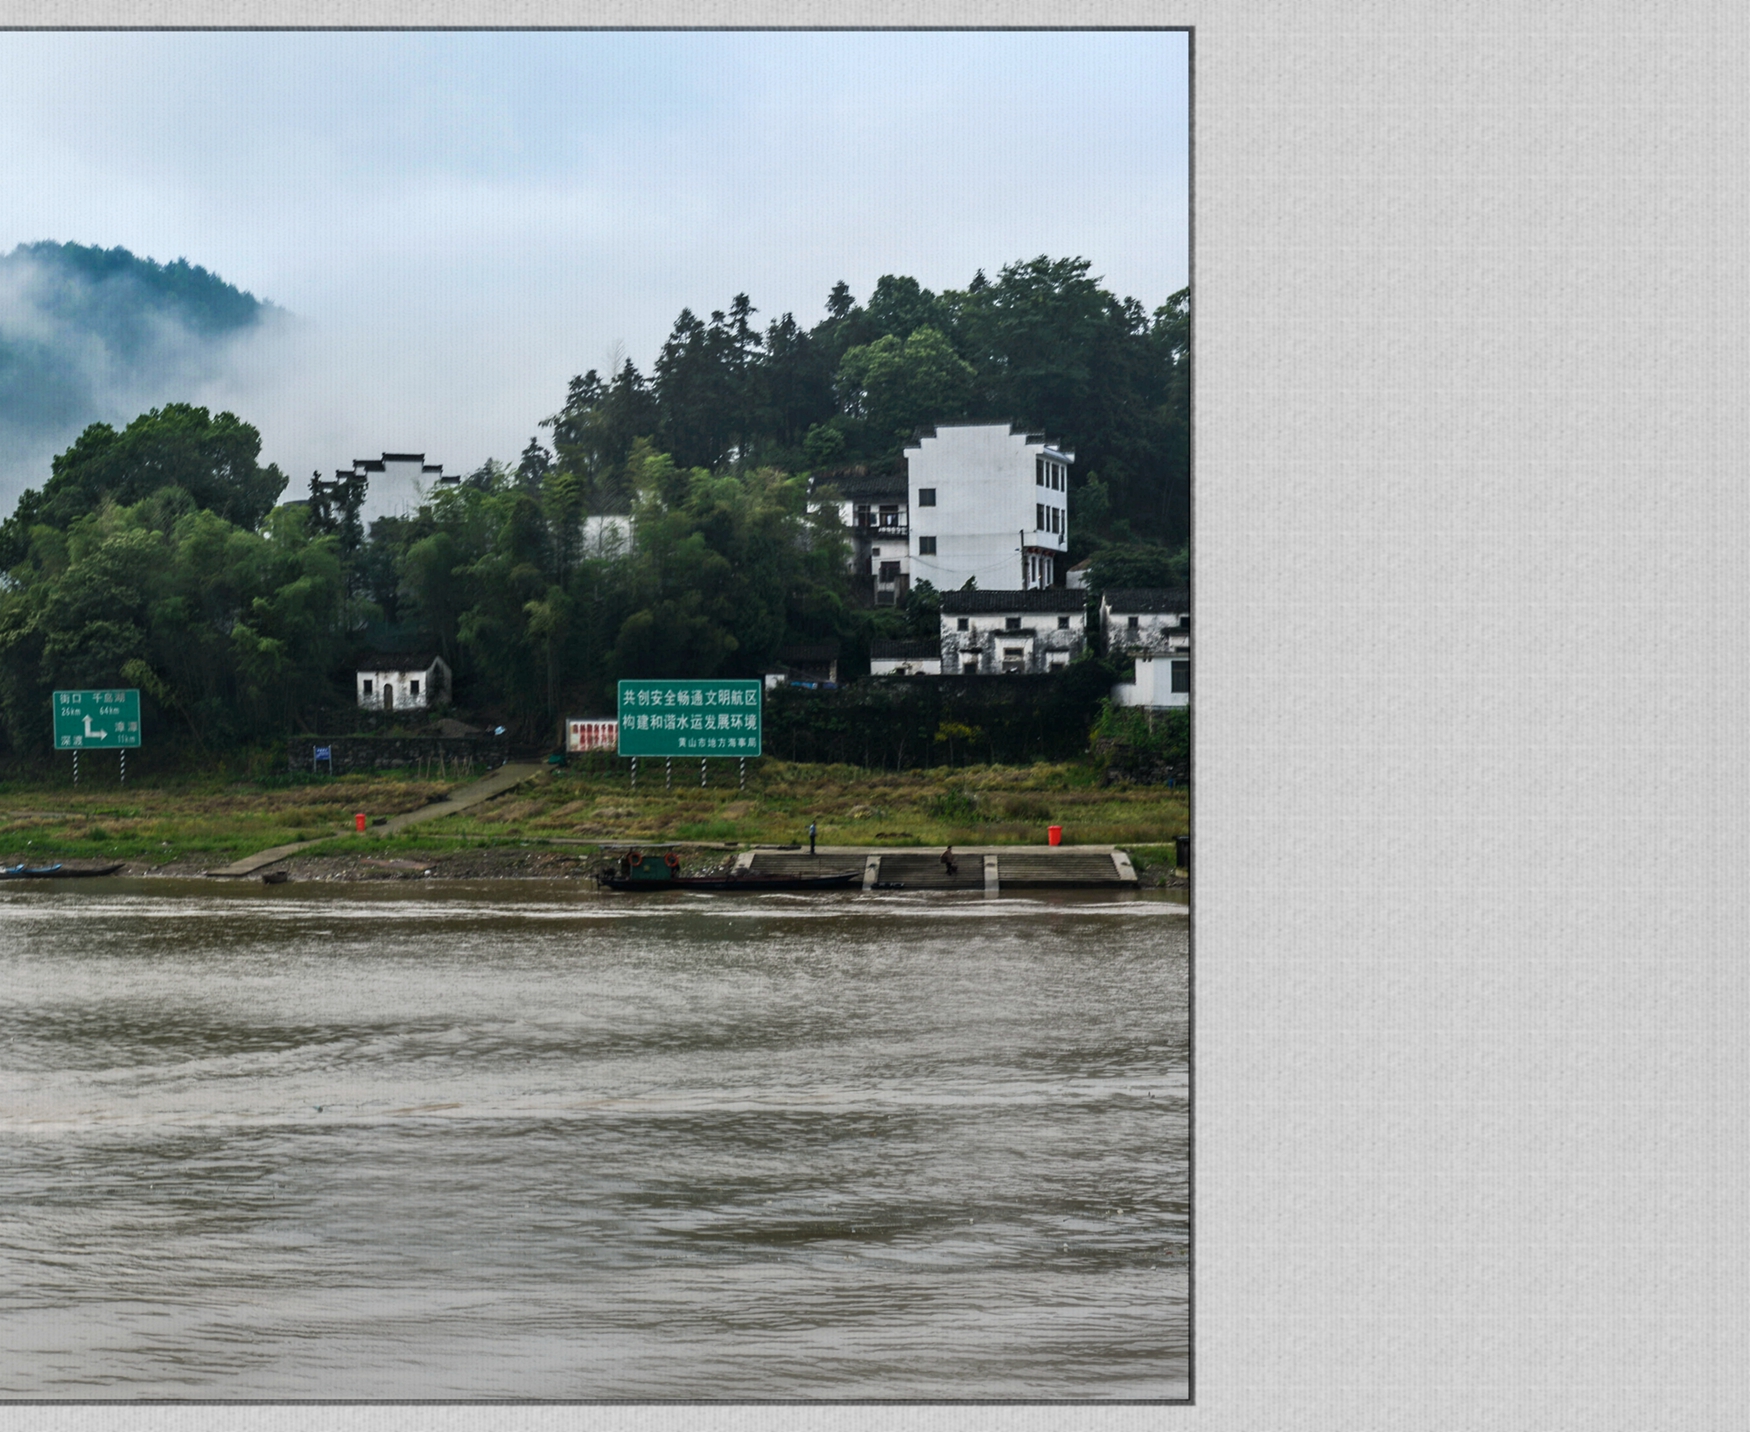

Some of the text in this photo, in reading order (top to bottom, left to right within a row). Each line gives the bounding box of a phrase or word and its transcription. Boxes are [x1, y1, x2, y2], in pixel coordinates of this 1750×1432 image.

[60, 693, 82, 704] 街口
[92, 692, 125, 703] 千岛湖
[623, 689, 757, 706] 共创安全畅通文明航区
[61, 706, 81, 716] 26km
[99, 706, 120, 716] 64km
[622, 713, 757, 730] 构建和谐水运发展环境
[61, 735, 83, 746] 深渡
[678, 737, 757, 749] 黄山市地方海事局
